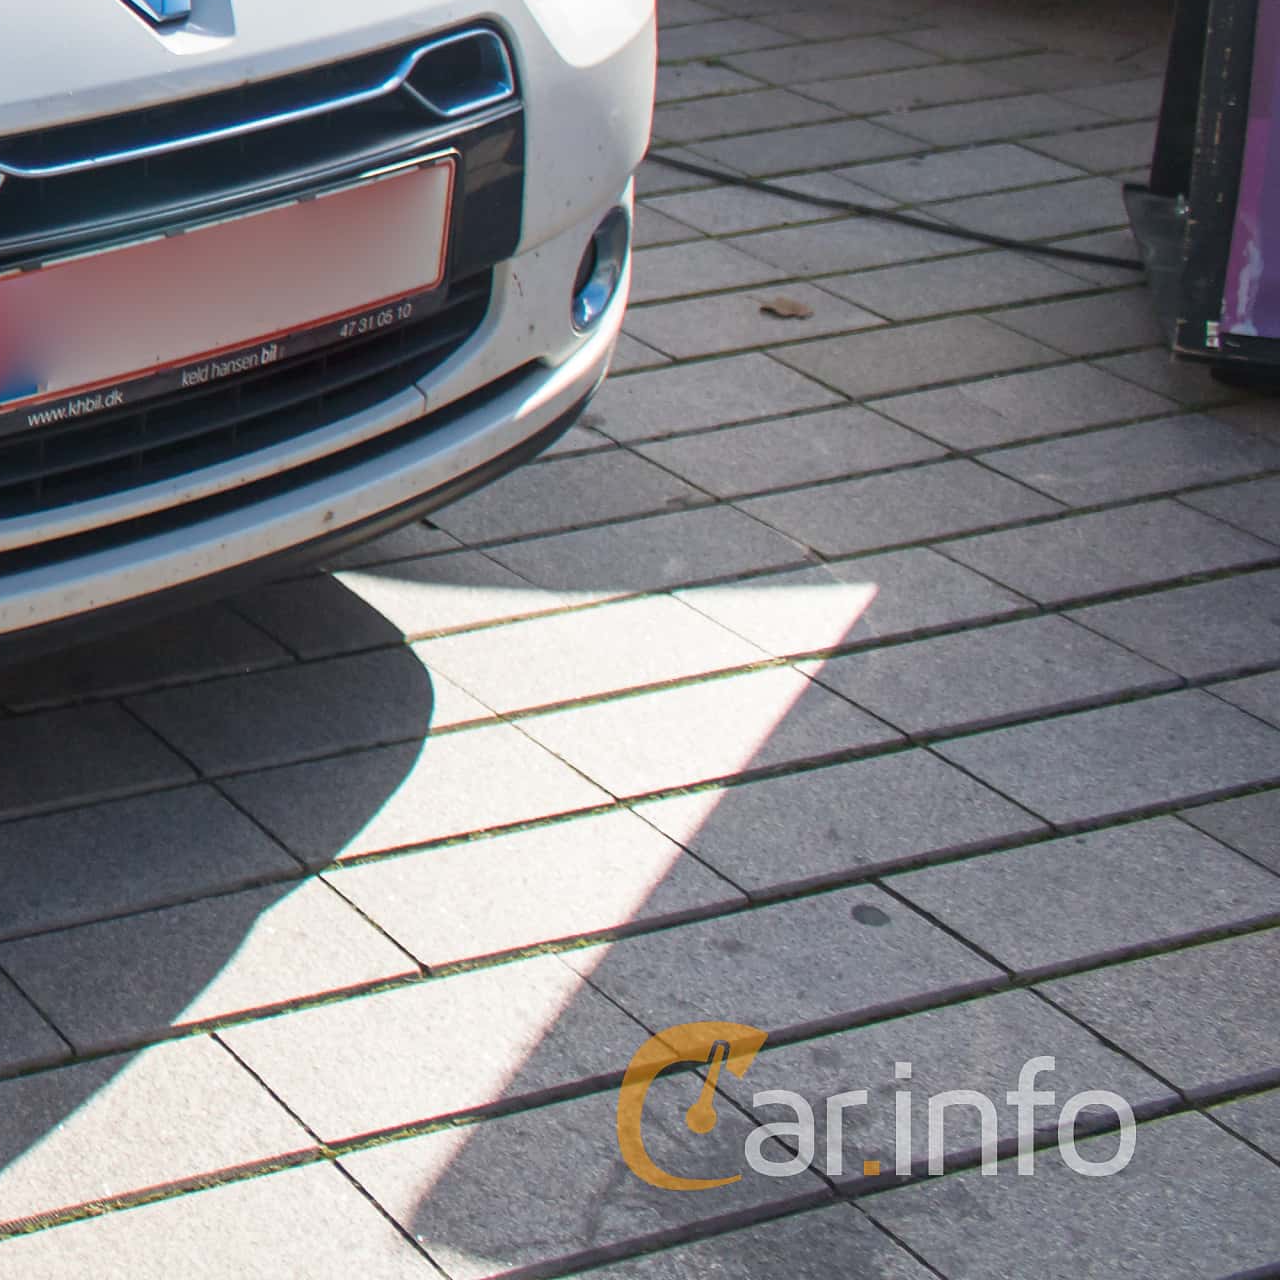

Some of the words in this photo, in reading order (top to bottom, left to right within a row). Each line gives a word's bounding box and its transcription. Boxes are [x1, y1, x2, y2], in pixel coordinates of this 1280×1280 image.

[339, 320, 357, 337] 47
[358, 315, 375, 334] 31
[397, 302, 413, 321] 10
[181, 364, 209, 387] keld
[210, 353, 258, 380] hansen
[260, 343, 278, 365] bil
[26, 388, 125, 428] www.khbil.dk
